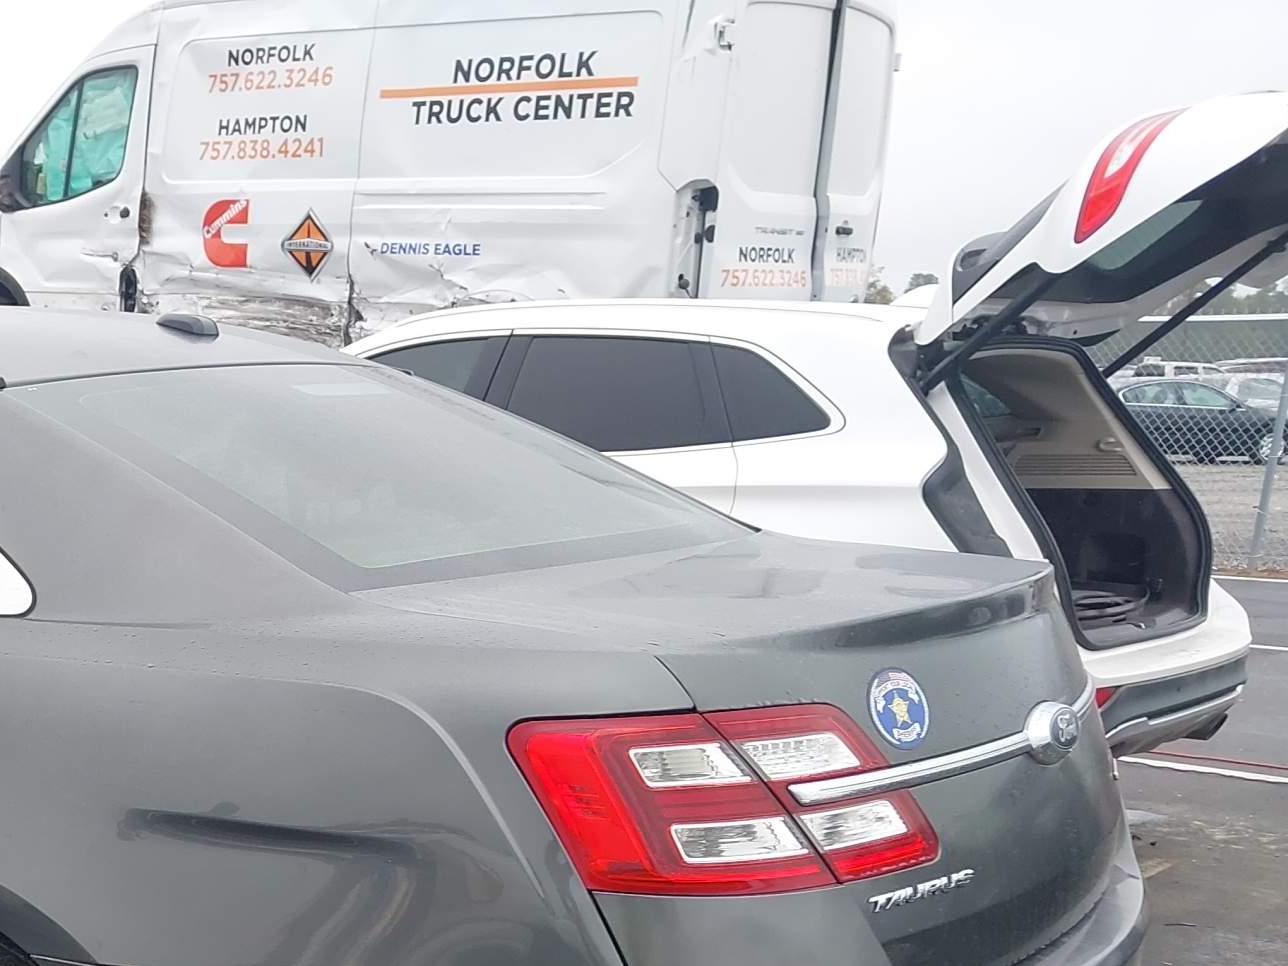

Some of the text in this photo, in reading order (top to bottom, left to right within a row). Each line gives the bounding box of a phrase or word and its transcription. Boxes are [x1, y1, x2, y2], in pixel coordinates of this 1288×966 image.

[227, 43, 316, 67] NORFOLK
[452, 50, 598, 84] NORFOLK
[208, 66, 334, 93] 757.622.3246
[412, 91, 635, 125] TRUCK CENTER
[218, 114, 308, 136] HAMPTON
[199, 137, 324, 161] 757.838.4241
[203, 199, 248, 239] Cummins
[380, 242, 481, 256] DENNIS EAGLE
[738, 246, 795, 264] NORFOLK
[720, 269, 807, 288] 757.622.3246
[868, 869, 976, 913] TAURUS
